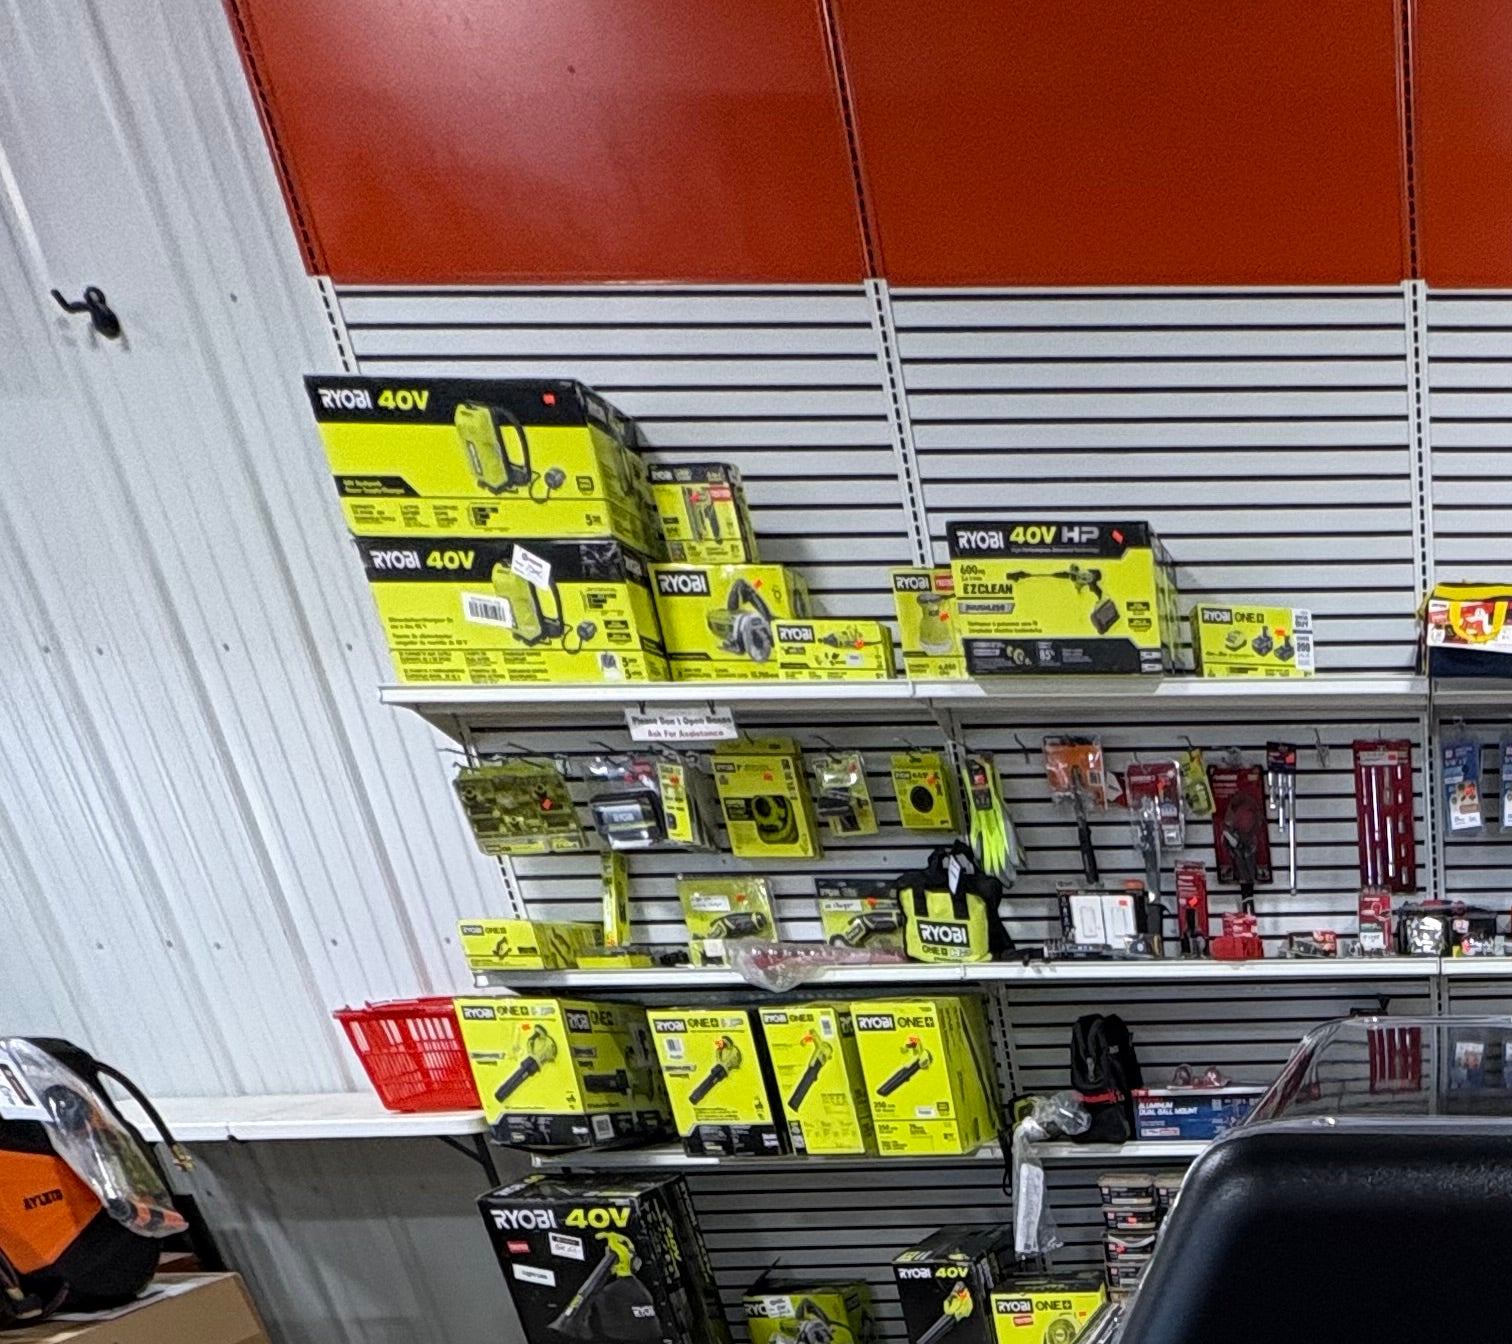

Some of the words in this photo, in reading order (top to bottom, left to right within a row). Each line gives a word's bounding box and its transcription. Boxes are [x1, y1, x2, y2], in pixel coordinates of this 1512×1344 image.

[318, 388, 374, 409] RYOBI
[378, 389, 429, 411] 40V
[956, 531, 1004, 550] RYOBI
[1009, 526, 1056, 544] 40V
[1061, 526, 1099, 544] HP
[370, 550, 422, 570] RYOBI
[426, 550, 475, 569] 40V
[657, 575, 708, 593] RYOBI
[896, 577, 930, 590] RYOBI
[963, 584, 1013, 595] EZCLEAN
[1203, 610, 1232, 623] RYOBI
[779, 627, 813, 641] RYOBI
[631, 716, 658, 724] Please
[682, 716, 705, 726] Open
[648, 729, 662, 737] Ask
[679, 729, 724, 738] Assistance
[920, 924, 967, 944] RYOBI
[463, 1007, 495, 1019] RYOBI
[764, 1014, 787, 1024] RYOBI
[656, 1021, 686, 1032] RYOBI
[858, 1017, 894, 1029] RYOBI
[897, 1017, 935, 1028] ONE+
[1175, 1107, 1198, 1115] MOUNT
[490, 1209, 557, 1230] RYOBI
[564, 1207, 631, 1228] 40V
[898, 1268, 932, 1279] RYOBI
[935, 1267, 968, 1278] 40V
[997, 1301, 1031, 1312] RYOBI
[1035, 1300, 1072, 1311] ONE+
